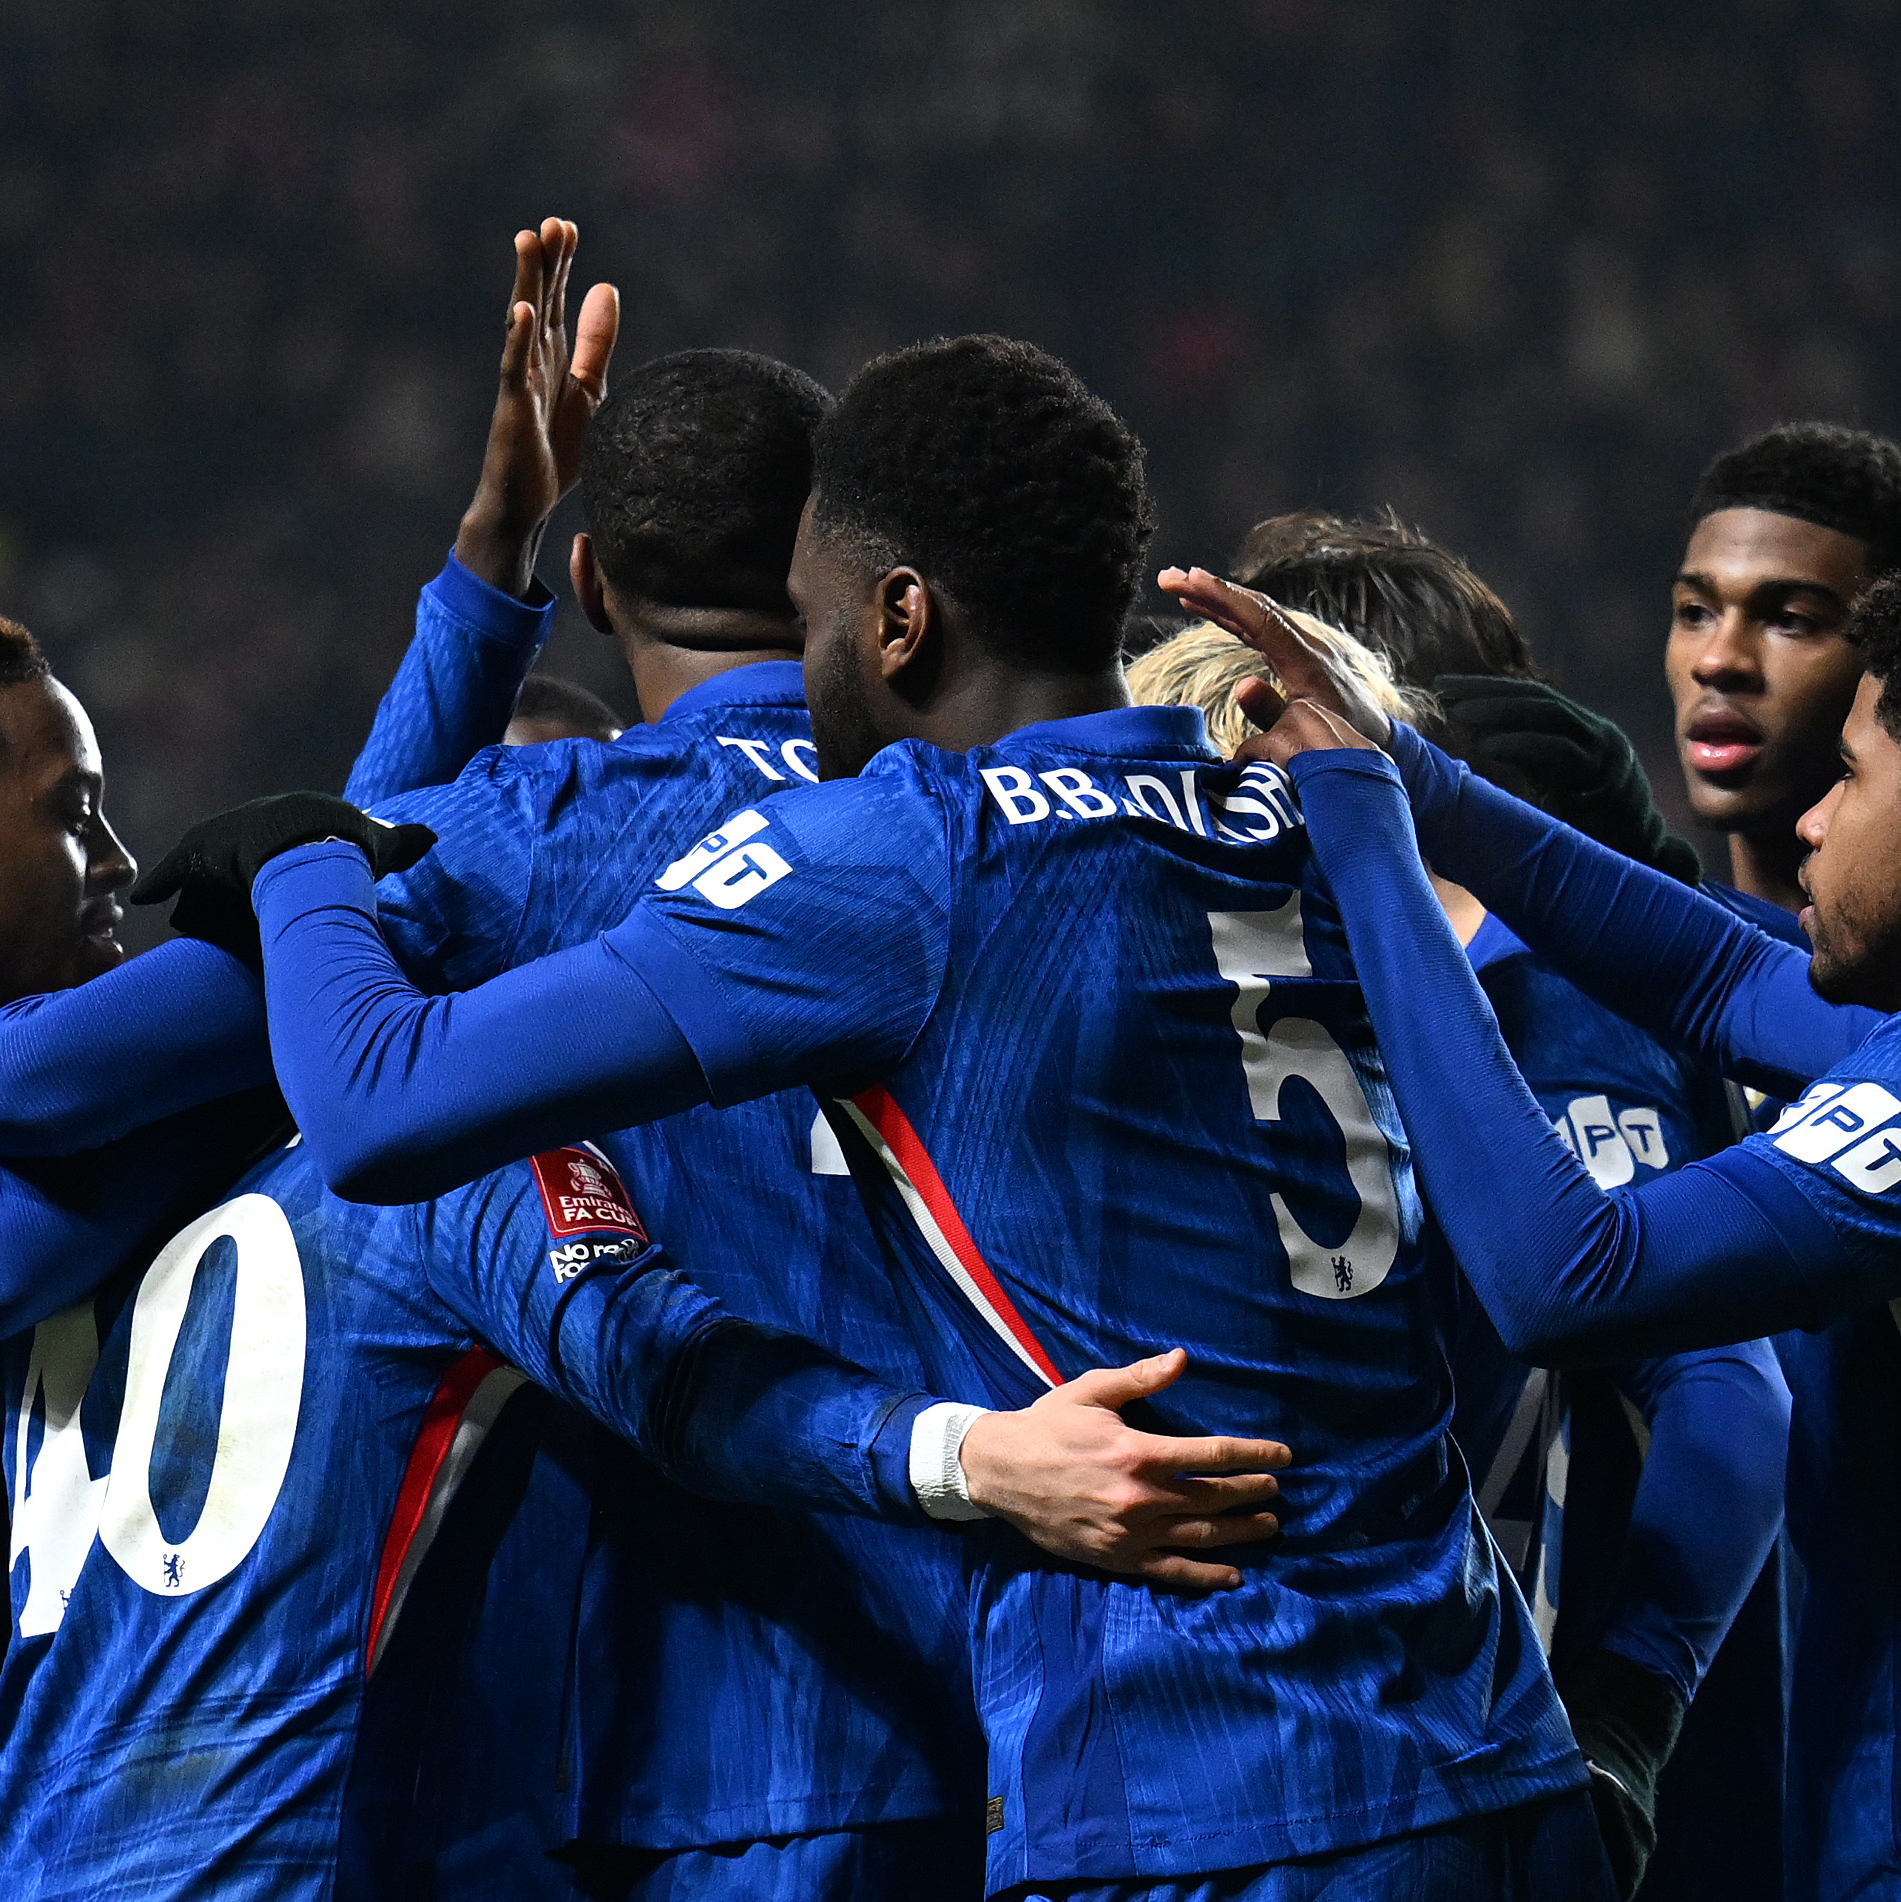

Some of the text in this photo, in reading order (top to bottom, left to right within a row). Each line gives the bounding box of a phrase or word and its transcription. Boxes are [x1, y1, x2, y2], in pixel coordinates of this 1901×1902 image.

[1207, 889, 1400, 1300] 5
[563, 1207, 638, 1227] FA CUP
